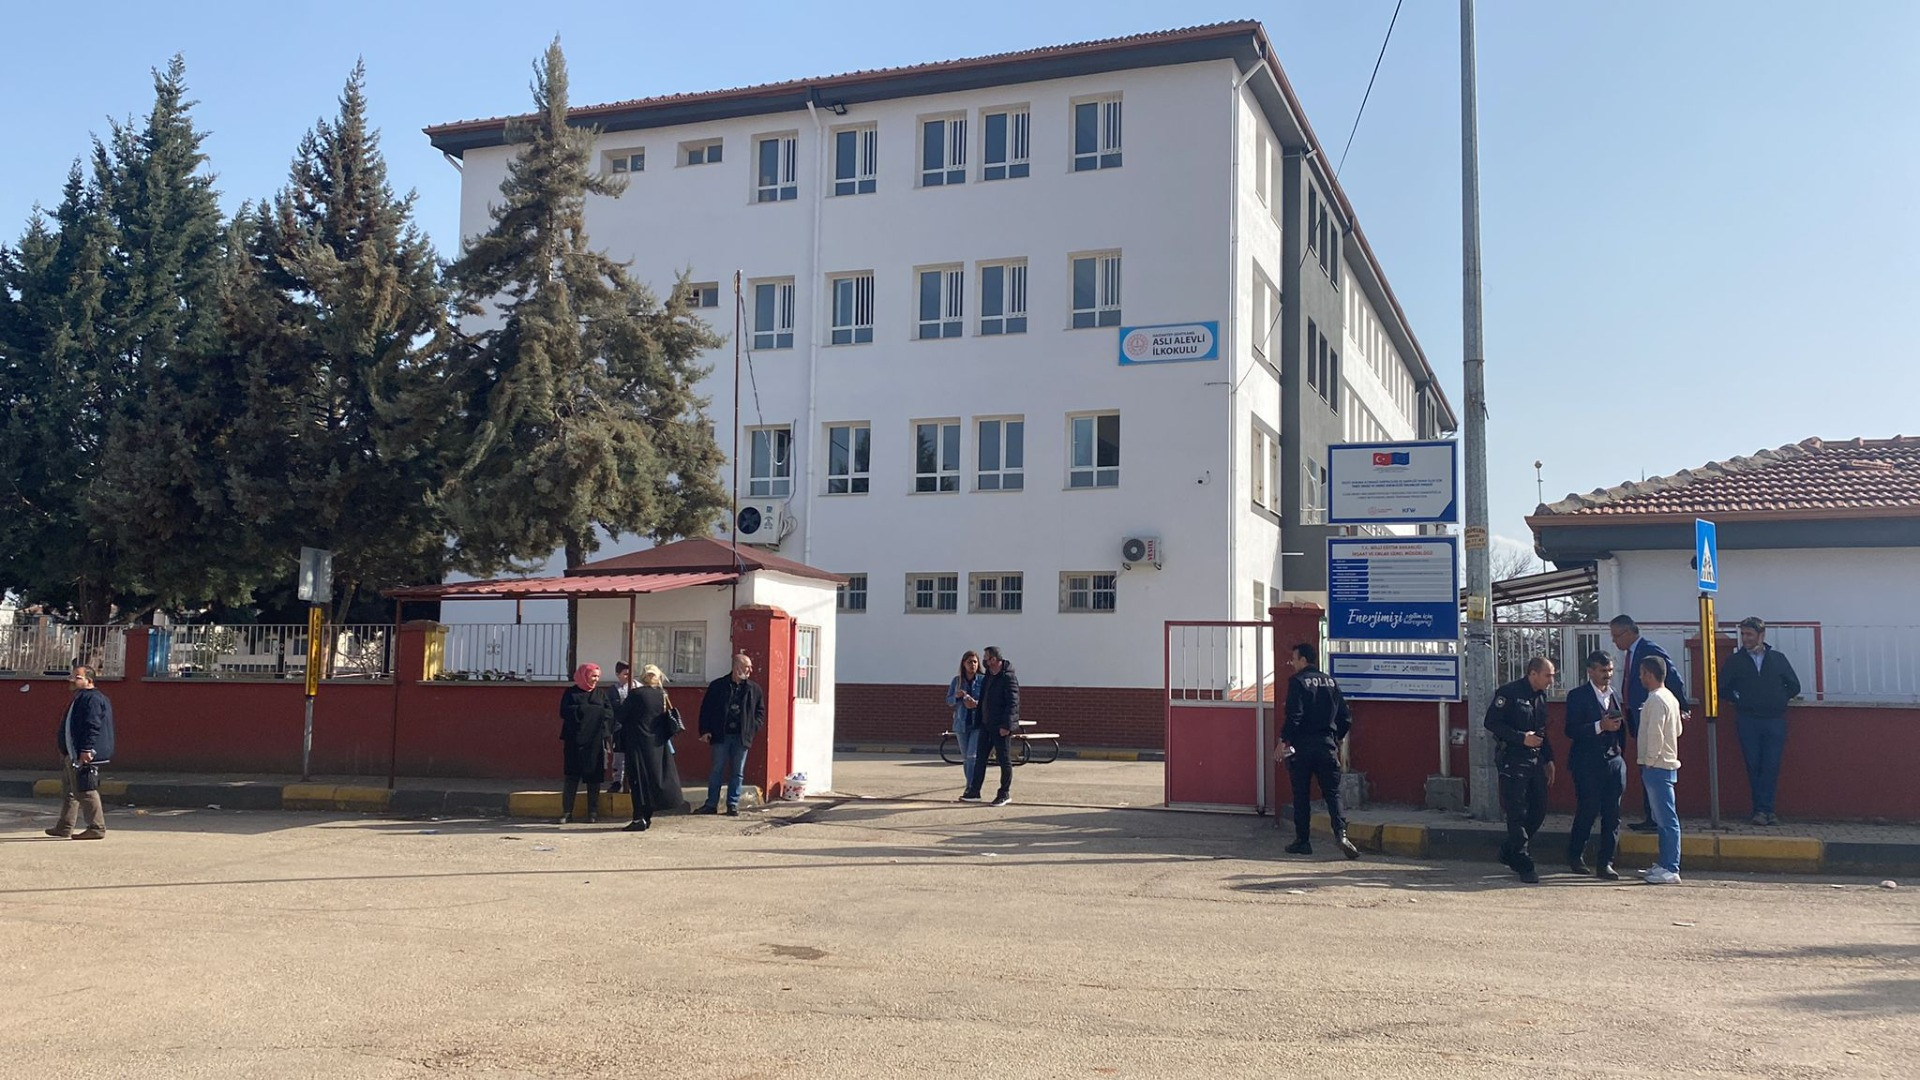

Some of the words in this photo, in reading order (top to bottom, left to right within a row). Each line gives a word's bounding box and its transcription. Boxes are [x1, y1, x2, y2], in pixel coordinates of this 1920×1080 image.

[1152, 337, 1172, 345] ASLI
[1174, 333, 1205, 344] ALEVLİ
[1152, 345, 1197, 356] İLKOKULU
[1347, 608, 1404, 629] Enerjimizi
